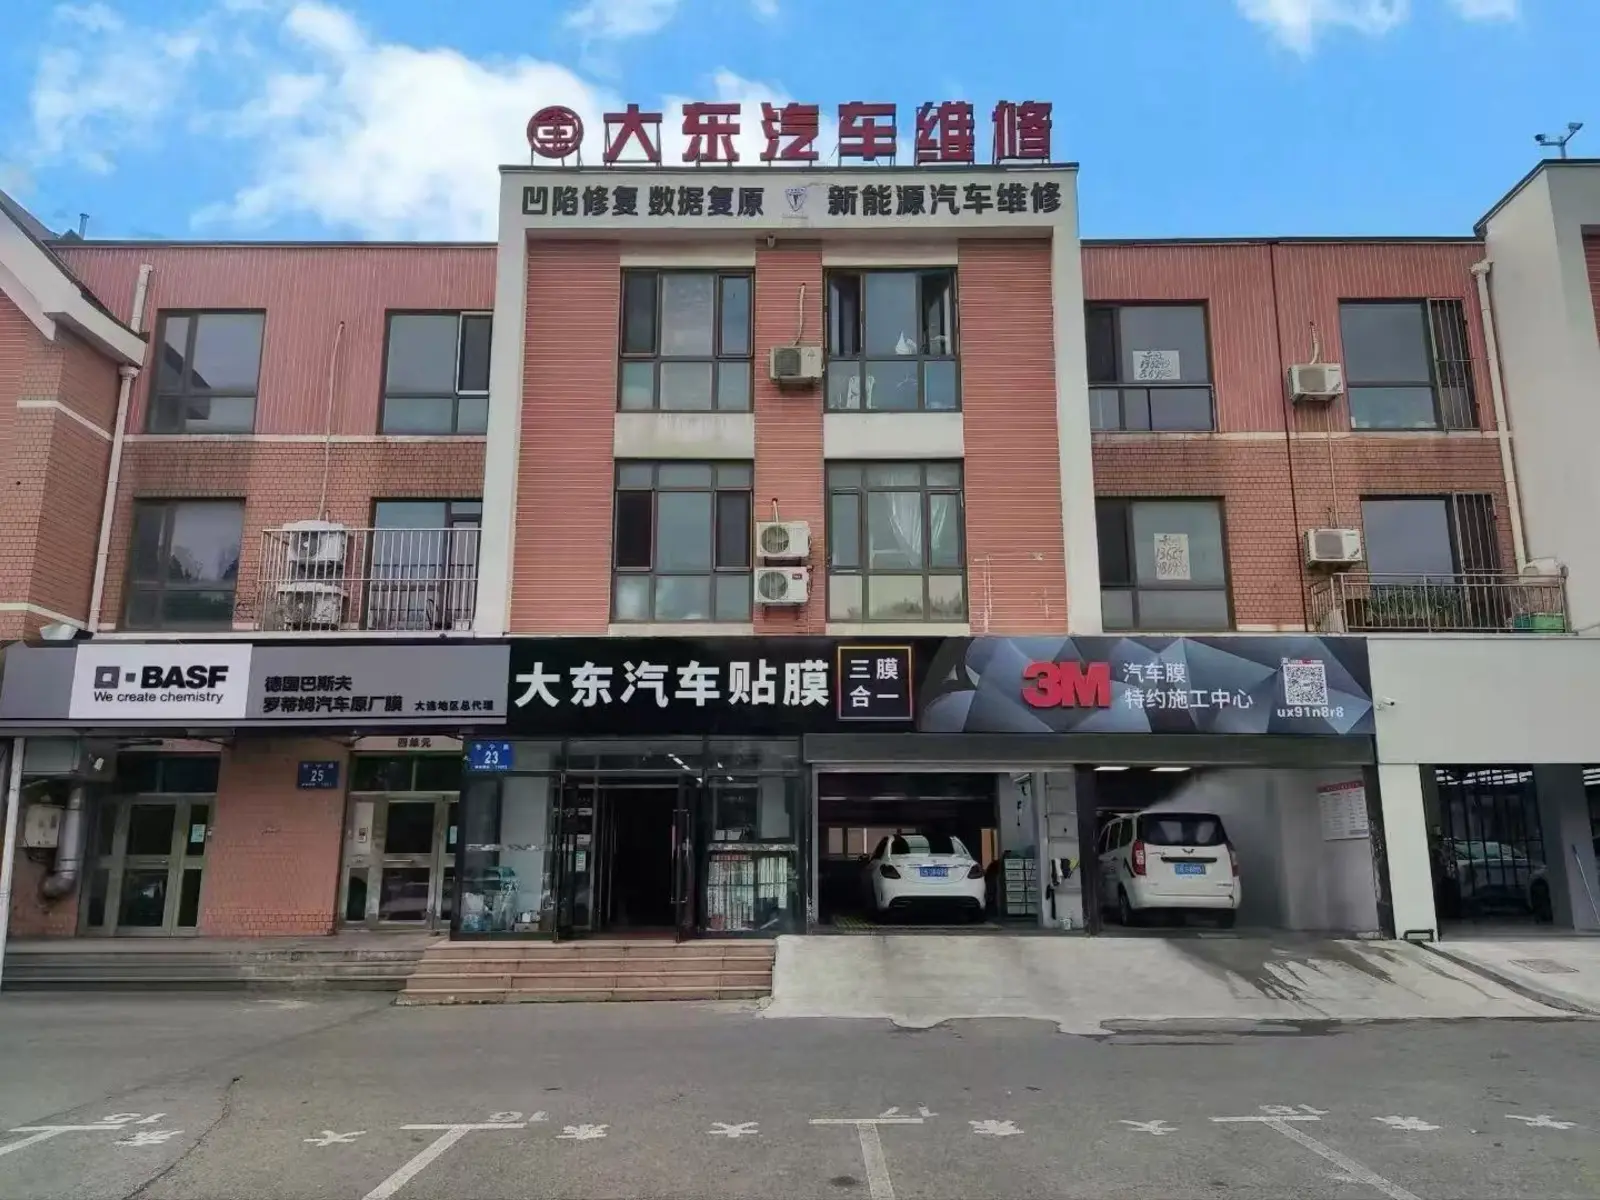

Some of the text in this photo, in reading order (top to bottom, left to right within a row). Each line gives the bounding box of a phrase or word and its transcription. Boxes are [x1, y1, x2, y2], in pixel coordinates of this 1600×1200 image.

[603, 100, 1052, 163] 大东汽车维修
[521, 181, 1062, 217] 凹陷修复 数据复原 新能源汽车维修
[141, 665, 229, 689] BASF
[849, 658, 899, 680] 三膜
[1123, 662, 1186, 683] 汽车膜
[265, 676, 352, 692] 德国巴斯夫
[514, 659, 830, 708] 大东汽车贴膜
[1021, 660, 1112, 710] 3M
[94, 690, 224, 704] We create chemistry
[414, 700, 494, 711] 大连地区总代理
[849, 685, 899, 708] 合一
[1124, 688, 1253, 709] 特约施工中心
[1277, 706, 1344, 718] ux91n8r8
[484, 750, 499, 764] 23
[310, 770, 324, 782] 25
